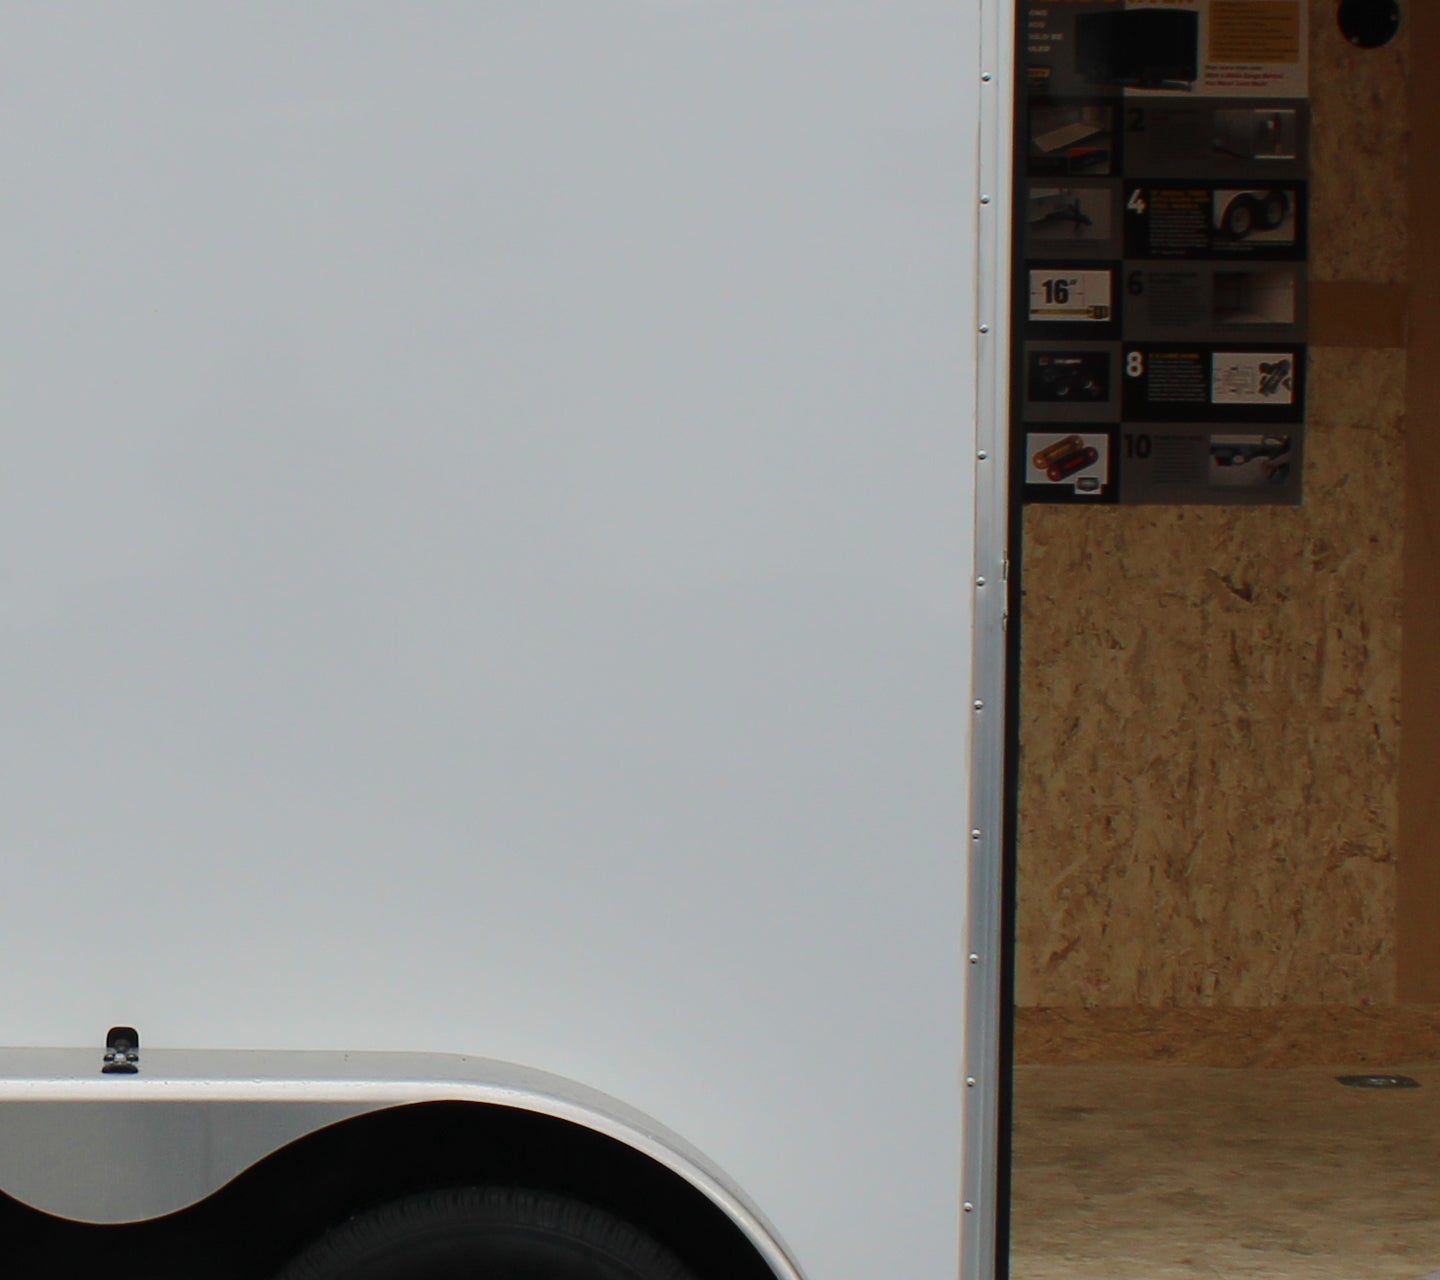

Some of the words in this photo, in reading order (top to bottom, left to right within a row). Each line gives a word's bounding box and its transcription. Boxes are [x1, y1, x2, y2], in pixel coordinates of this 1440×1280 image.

[1127, 188, 1148, 214] 4
[1126, 351, 1144, 377] 8
[1124, 434, 1152, 459] 10
